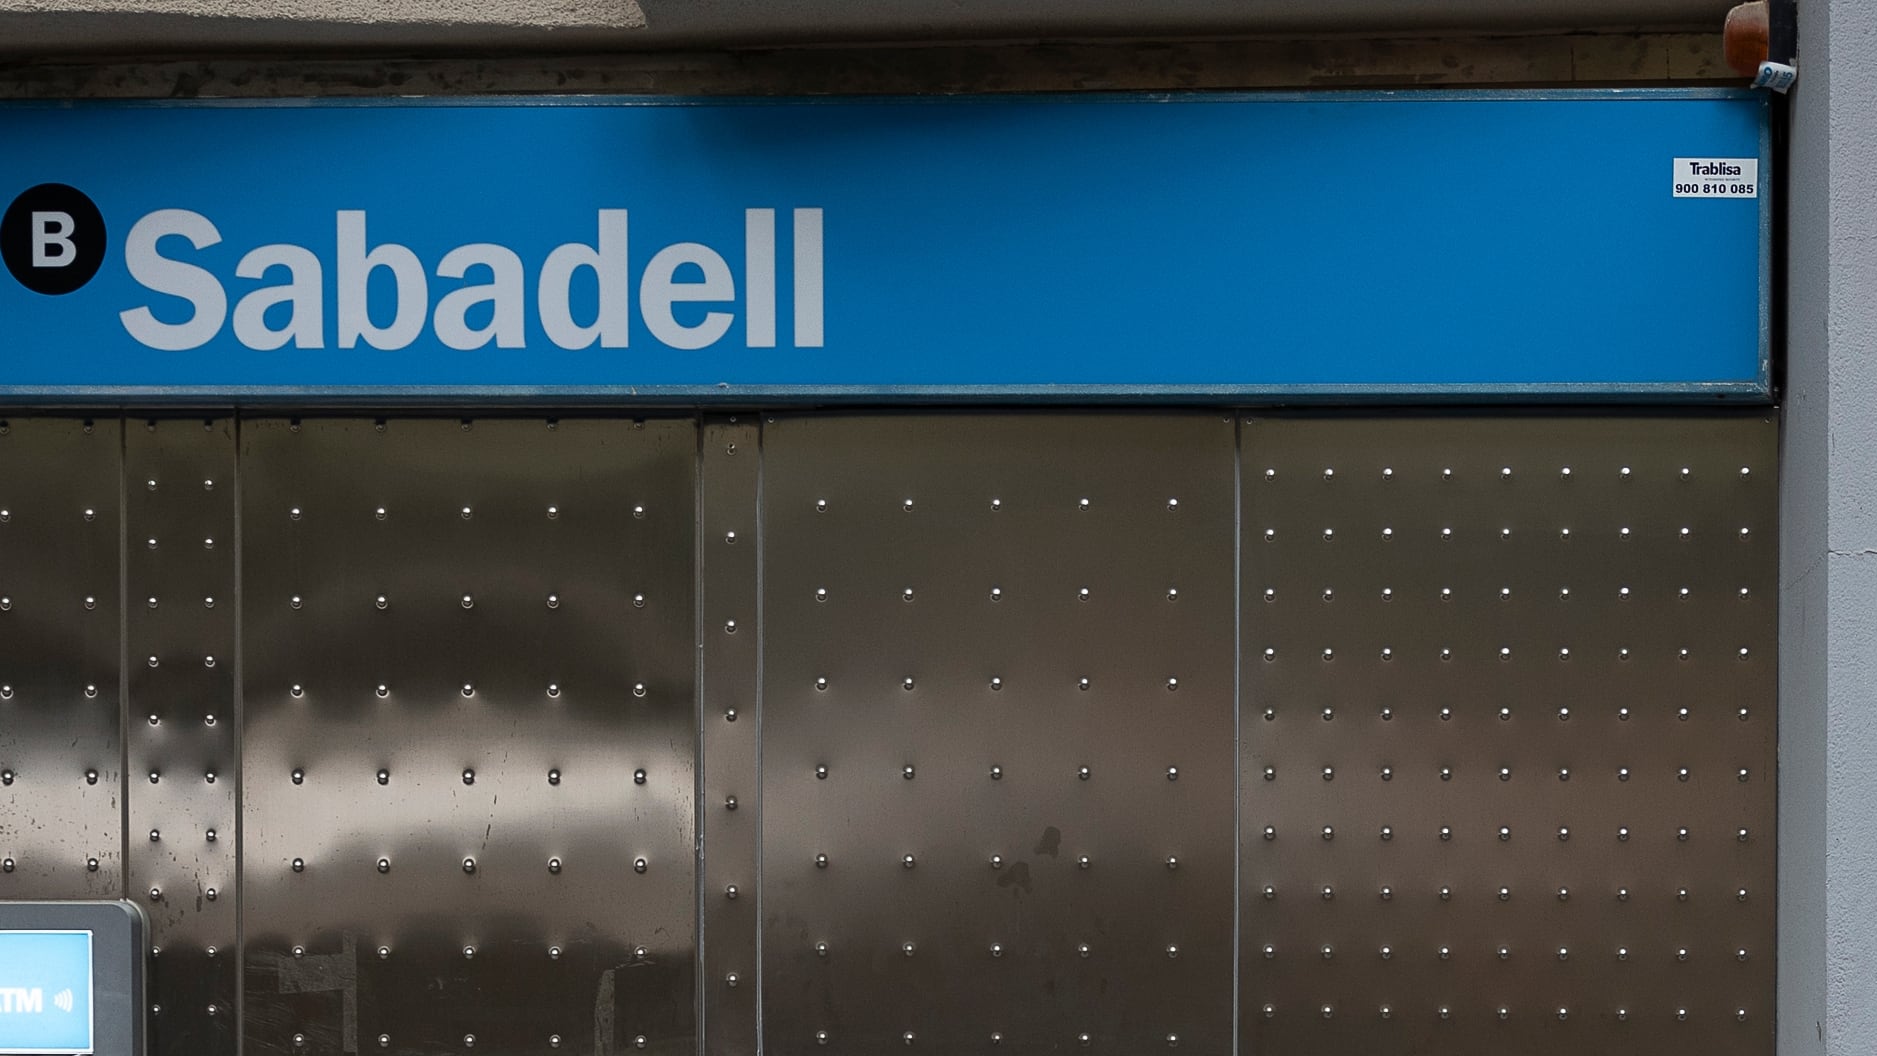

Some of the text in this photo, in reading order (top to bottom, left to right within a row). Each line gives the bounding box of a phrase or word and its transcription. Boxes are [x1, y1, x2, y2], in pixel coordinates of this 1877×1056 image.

[1689, 161, 1741, 176] Trablisa
[1675, 183, 1754, 194] 900 810 085
[31, 211, 77, 268] B
[119, 207, 825, 352] Sabadell
[0, 987, 43, 1013] TM
